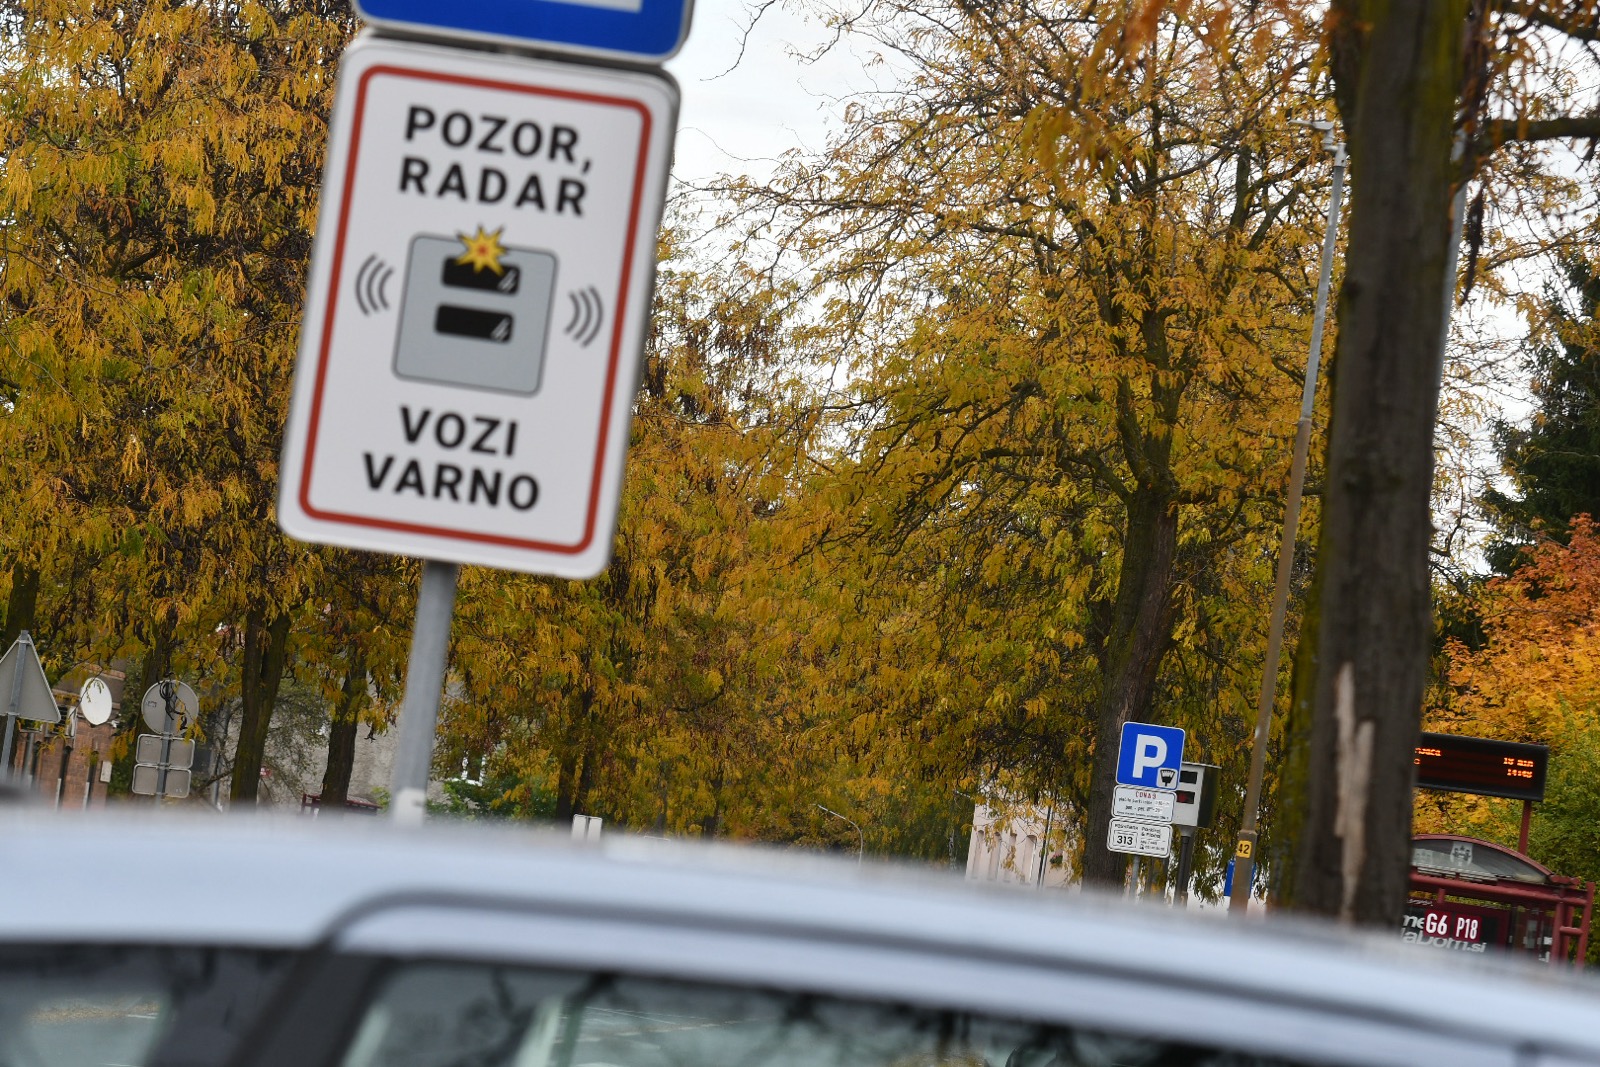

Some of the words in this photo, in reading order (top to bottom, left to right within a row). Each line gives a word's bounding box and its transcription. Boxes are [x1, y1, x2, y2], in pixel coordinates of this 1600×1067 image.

[404, 104, 592, 175] POZOR,
[399, 156, 587, 217] RADAR
[401, 405, 518, 457] VOZI
[363, 452, 540, 511] VARNO
[1132, 733, 1168, 779] P
[1116, 835, 1133, 846] 313
[1425, 912, 1448, 936] G6
[1455, 917, 1479, 940] P18
